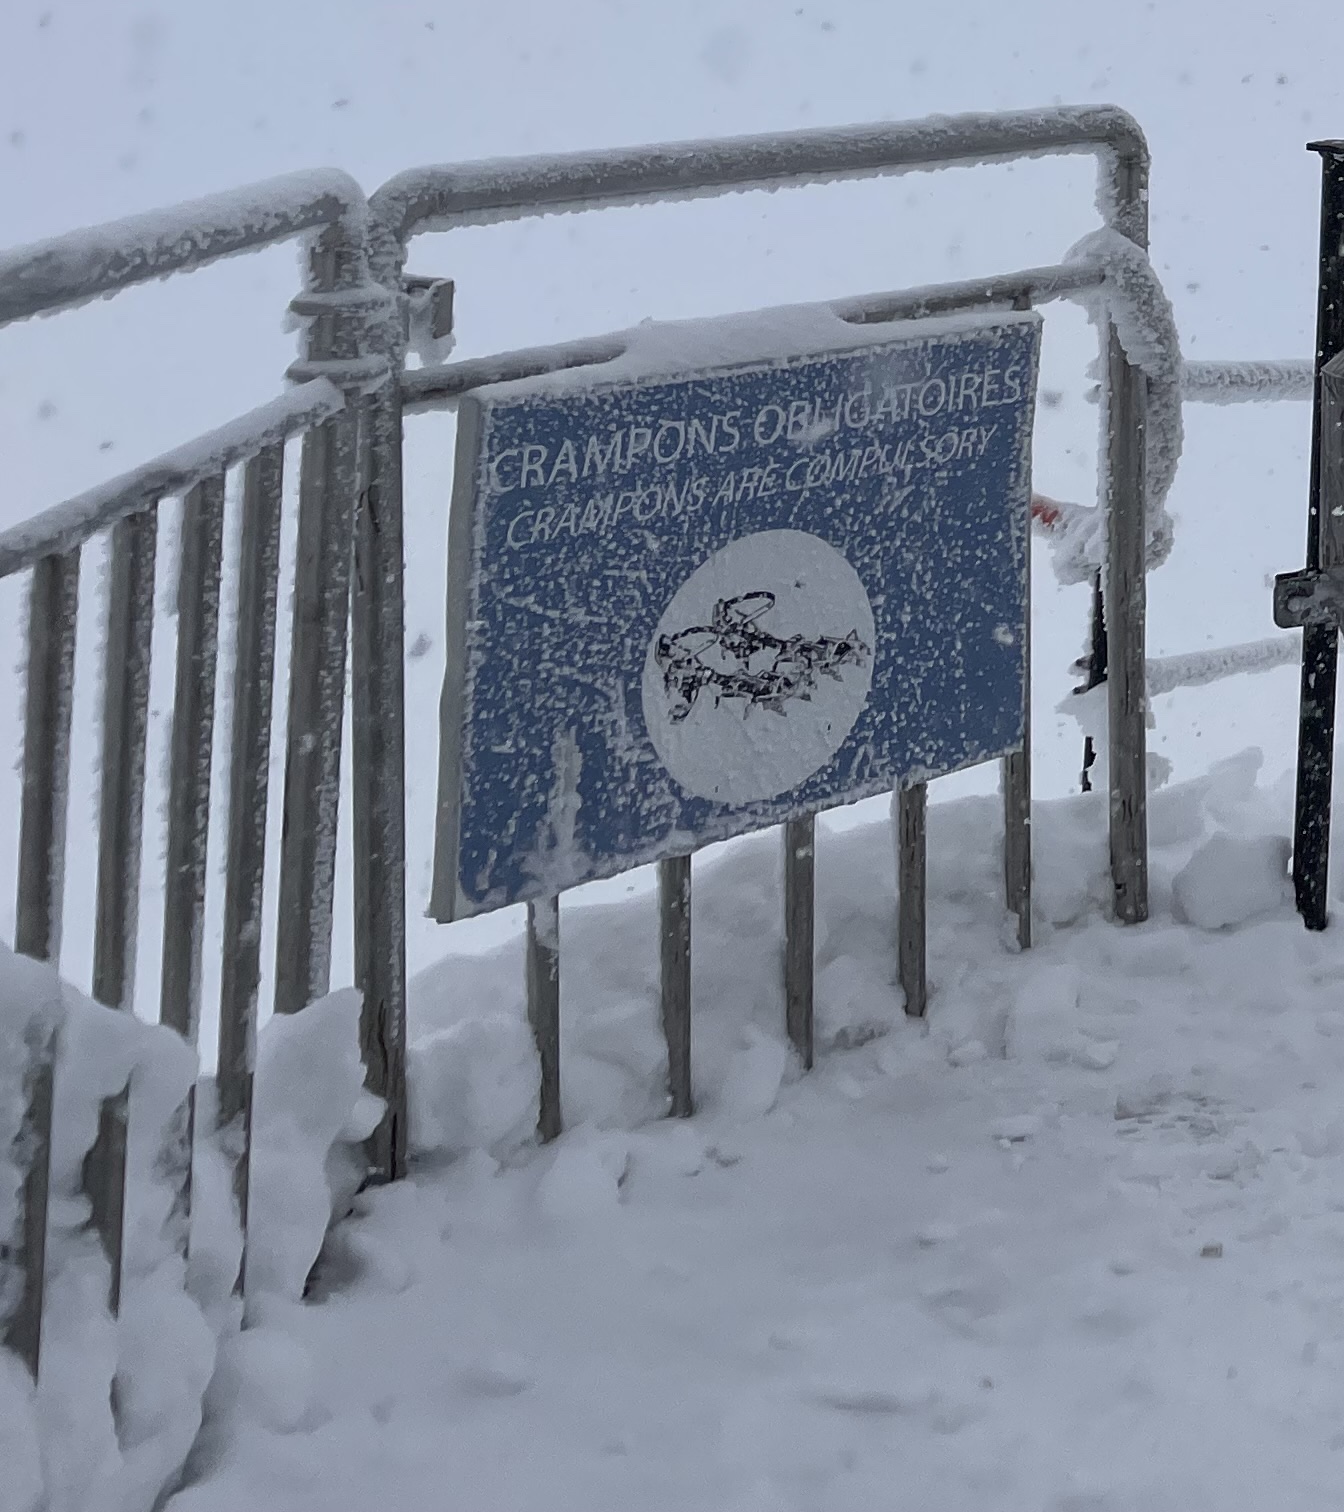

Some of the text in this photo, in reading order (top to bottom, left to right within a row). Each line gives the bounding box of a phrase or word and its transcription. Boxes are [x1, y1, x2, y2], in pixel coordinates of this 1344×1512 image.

[488, 365, 1022, 493] CRAMPONS OBLIGATOIRES
[506, 424, 998, 551] CRAMPONS ARE COMPULSORY
